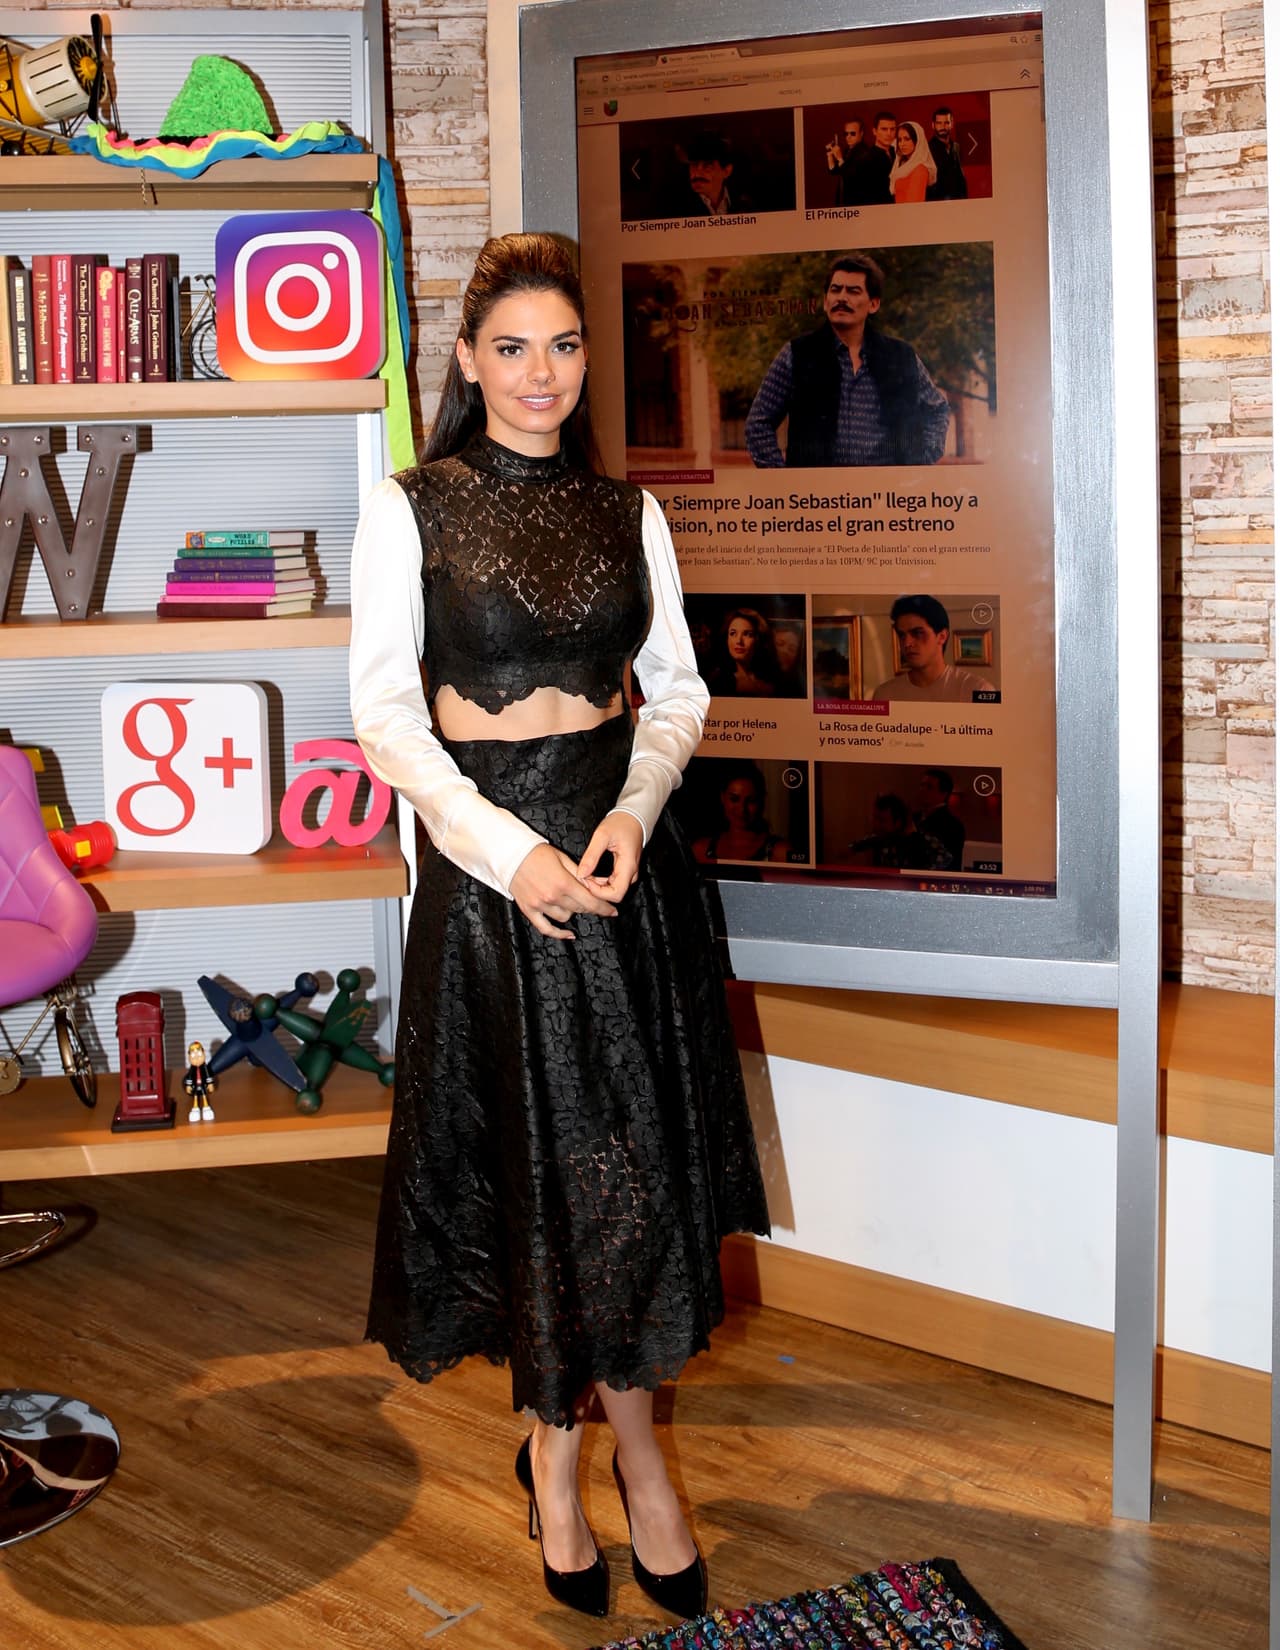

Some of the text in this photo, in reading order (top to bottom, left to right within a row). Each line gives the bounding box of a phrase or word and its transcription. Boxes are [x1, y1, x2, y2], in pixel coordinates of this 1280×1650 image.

[621, 215, 757, 233] Por Siempre Joan Sebastian
[805, 211, 815, 221] El
[151, 263, 159, 277] The
[151, 277, 159, 309] Chamber
[720, 298, 817, 319] SEBASTIAN
[79, 316, 88, 333] John
[150, 313, 159, 330] John
[80, 333, 88, 363] Grisham
[672, 494, 741, 514] Siempre
[744, 494, 785, 510] Joan
[789, 492, 881, 510] Sebastian"
[886, 491, 927, 513] llega
[931, 491, 964, 512] hoy
[968, 495, 978, 508] a
[0, 426, 136, 621] W
[667, 515, 955, 536] ision, no te pierdas el gran estreno
[685, 546, 705, 556] parte
[706, 544, 718, 553] del
[720, 544, 742, 553] inicio
[743, 544, 756, 553] del
[757, 546, 775, 555] gran
[776, 544, 816, 555] homenaje
[837, 544, 860, 553] Poeta
[861, 544, 871, 553] de
[928, 544, 937, 553] el
[938, 546, 958, 555] gran
[959, 545, 991, 553] estreno
[678, 559, 693, 567] pre
[694, 557, 711, 567] Joan
[757, 557, 769, 565] No
[778, 557, 788, 565] lo
[789, 557, 816, 567] pierdas
[825, 557, 838, 566] las
[867, 557, 879, 565] 9C
[879, 559, 893, 567] por
[895, 557, 937, 566] Univision.
[977, 693, 996, 701] 43:37
[703, 718, 777, 730] star por Helena
[819, 721, 831, 732] La
[833, 721, 858, 732] Rosa
[860, 722, 873, 733] de
[875, 722, 932, 736] Guadalupe
[940, 724, 957, 735] 'La
[958, 724, 993, 736] última
[720, 732, 732, 742] de
[734, 732, 755, 742] Oro'
[819, 737, 825, 747] y
[827, 736, 846, 746] nos
[847, 736, 884, 747] vamos'
[117, 698, 252, 837] g+
[979, 863, 998, 871] 43:52
